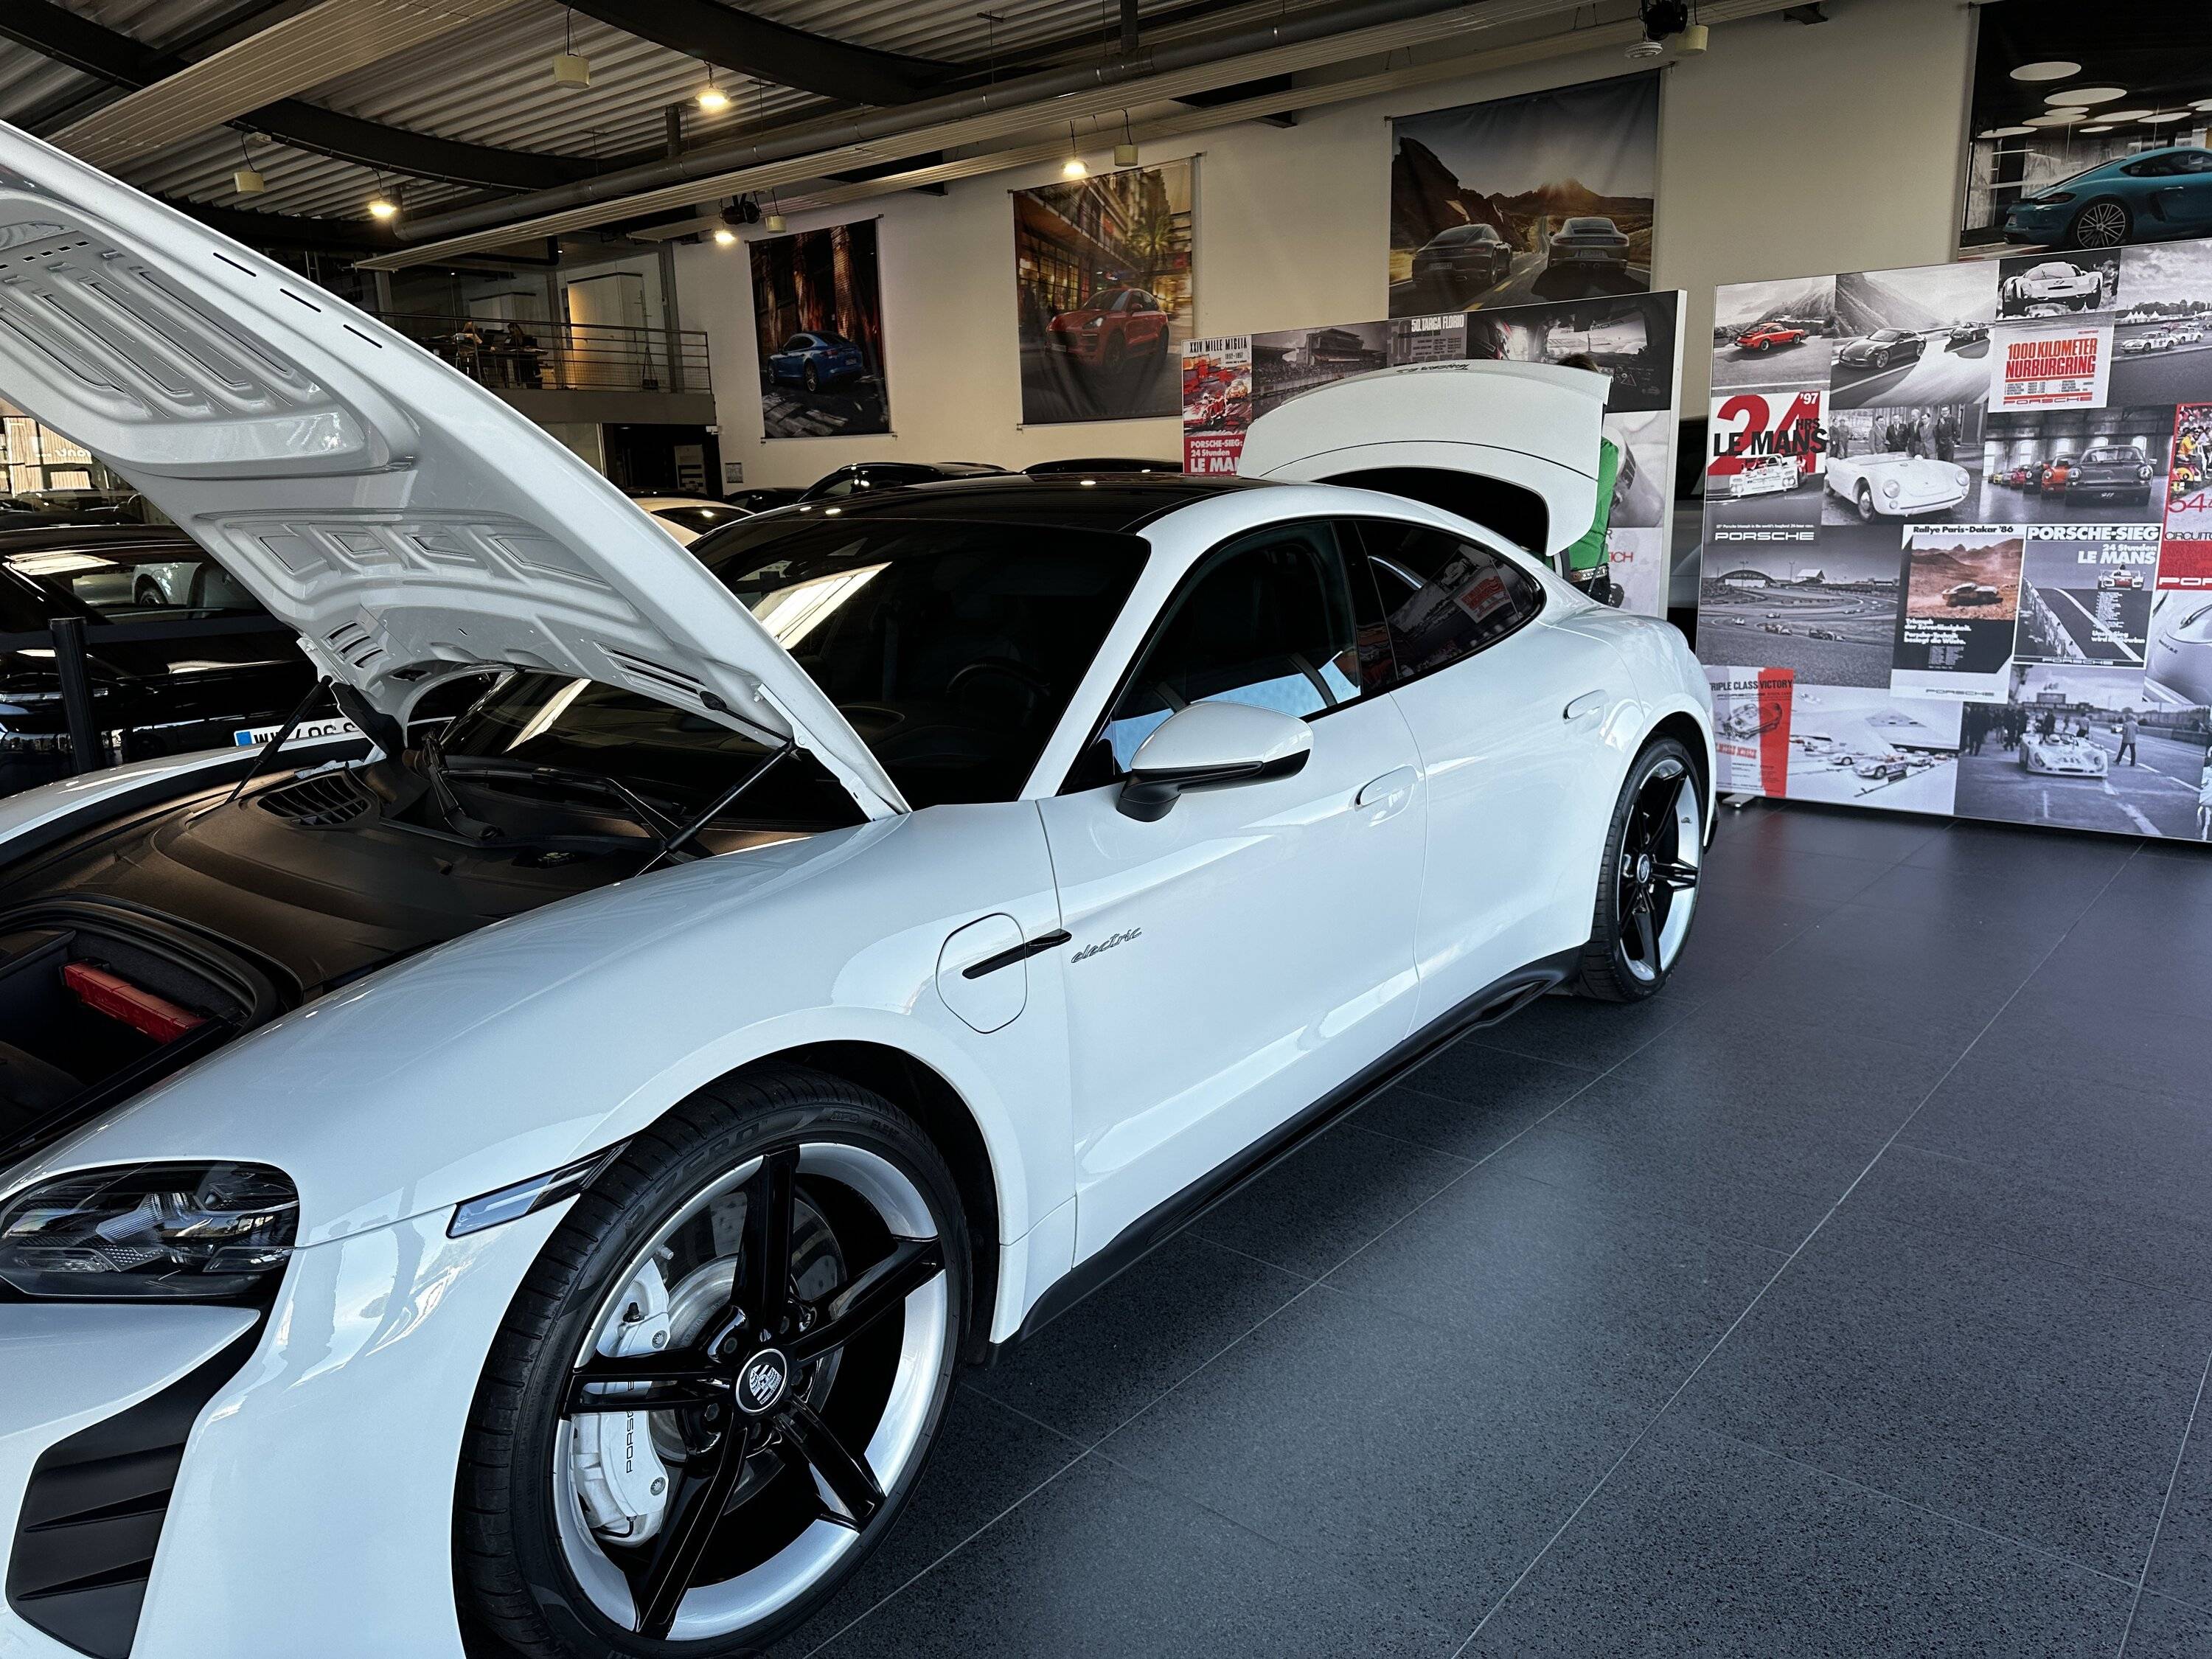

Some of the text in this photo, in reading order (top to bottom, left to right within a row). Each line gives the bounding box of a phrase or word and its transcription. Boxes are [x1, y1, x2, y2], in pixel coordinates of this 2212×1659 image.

[1422, 316, 1441, 331] TARGA
[1442, 314, 1465, 329] FLORIO
[1189, 337, 1248, 353] XXIV MILLE MIGLIA
[2007, 338, 2098, 360] 1000 KILOMETER
[2005, 355, 2097, 378] NURBURGRING
[1799, 392, 1819, 405] '97
[2003, 396, 2093, 406] PORSCHE
[1795, 417, 1820, 431] HRS
[1708, 391, 1820, 476] 24
[1190, 439, 1243, 448] PORSCHE-SIEG:
[1714, 428, 1830, 457] LE MANS
[1191, 448, 1231, 457] 24 Stunden
[1190, 457, 1206, 473] LE
[1714, 532, 1815, 541] PORSCHE
[1913, 525, 2014, 535] Rallye Paris-Dakar '86
[2028, 526, 2160, 540] PORSCHE-SIEG
[2118, 543, 2157, 552] Stunden
[2077, 551, 2156, 565] LE MANS
[1733, 681, 1758, 691] CLASS
[1759, 679, 1793, 689] VICTORY
[1071, 927, 1142, 964] electric
